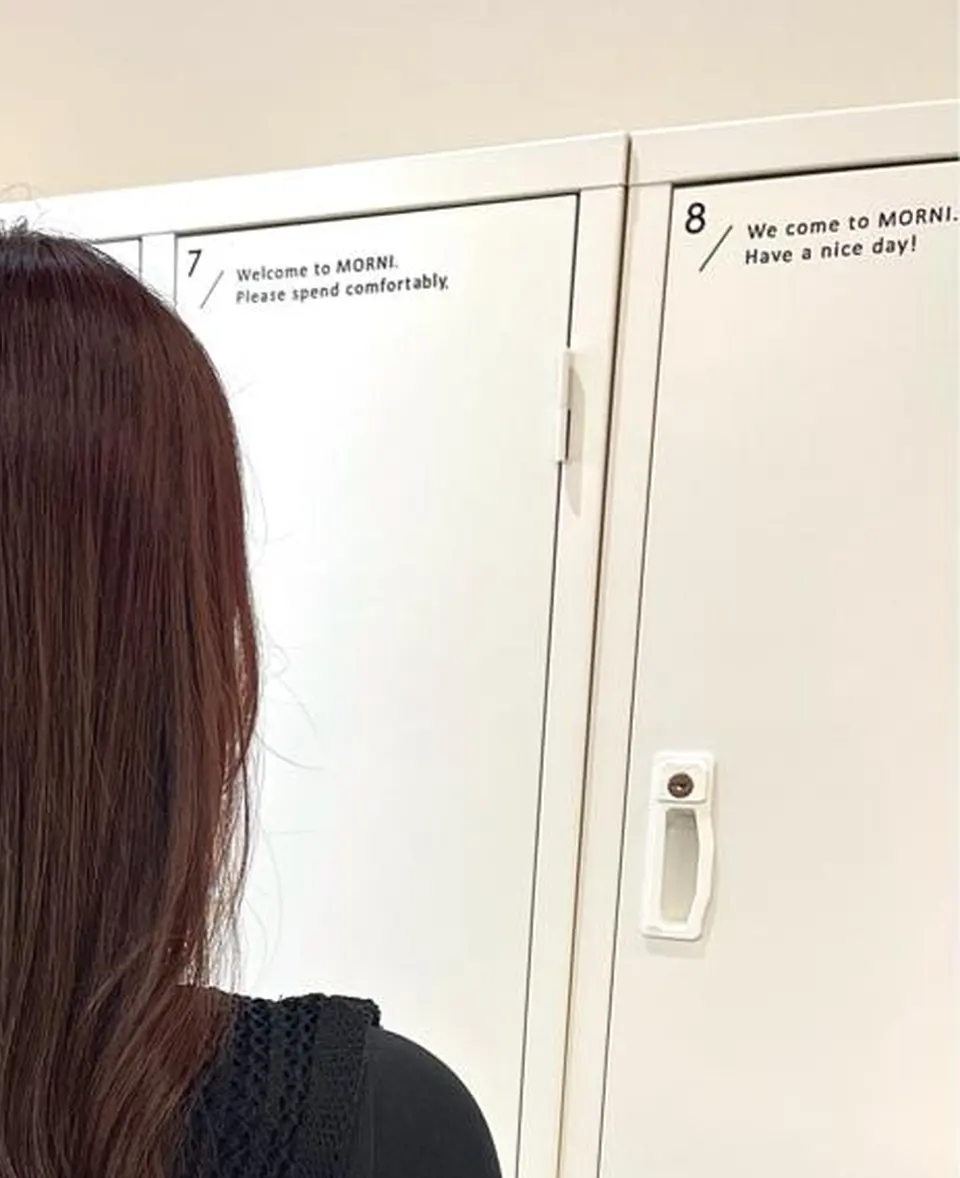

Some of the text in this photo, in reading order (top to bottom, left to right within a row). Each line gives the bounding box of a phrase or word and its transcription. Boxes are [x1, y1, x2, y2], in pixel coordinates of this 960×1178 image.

[685, 202, 706, 235] 8
[849, 216, 870, 231] to
[878, 205, 958, 228] MORNI.
[188, 249, 202, 278] 7
[745, 234, 916, 265] Have a nice day!
[236, 254, 399, 283] Welcome to MORNI.
[236, 288, 286, 304] Please
[292, 282, 340, 303] spend
